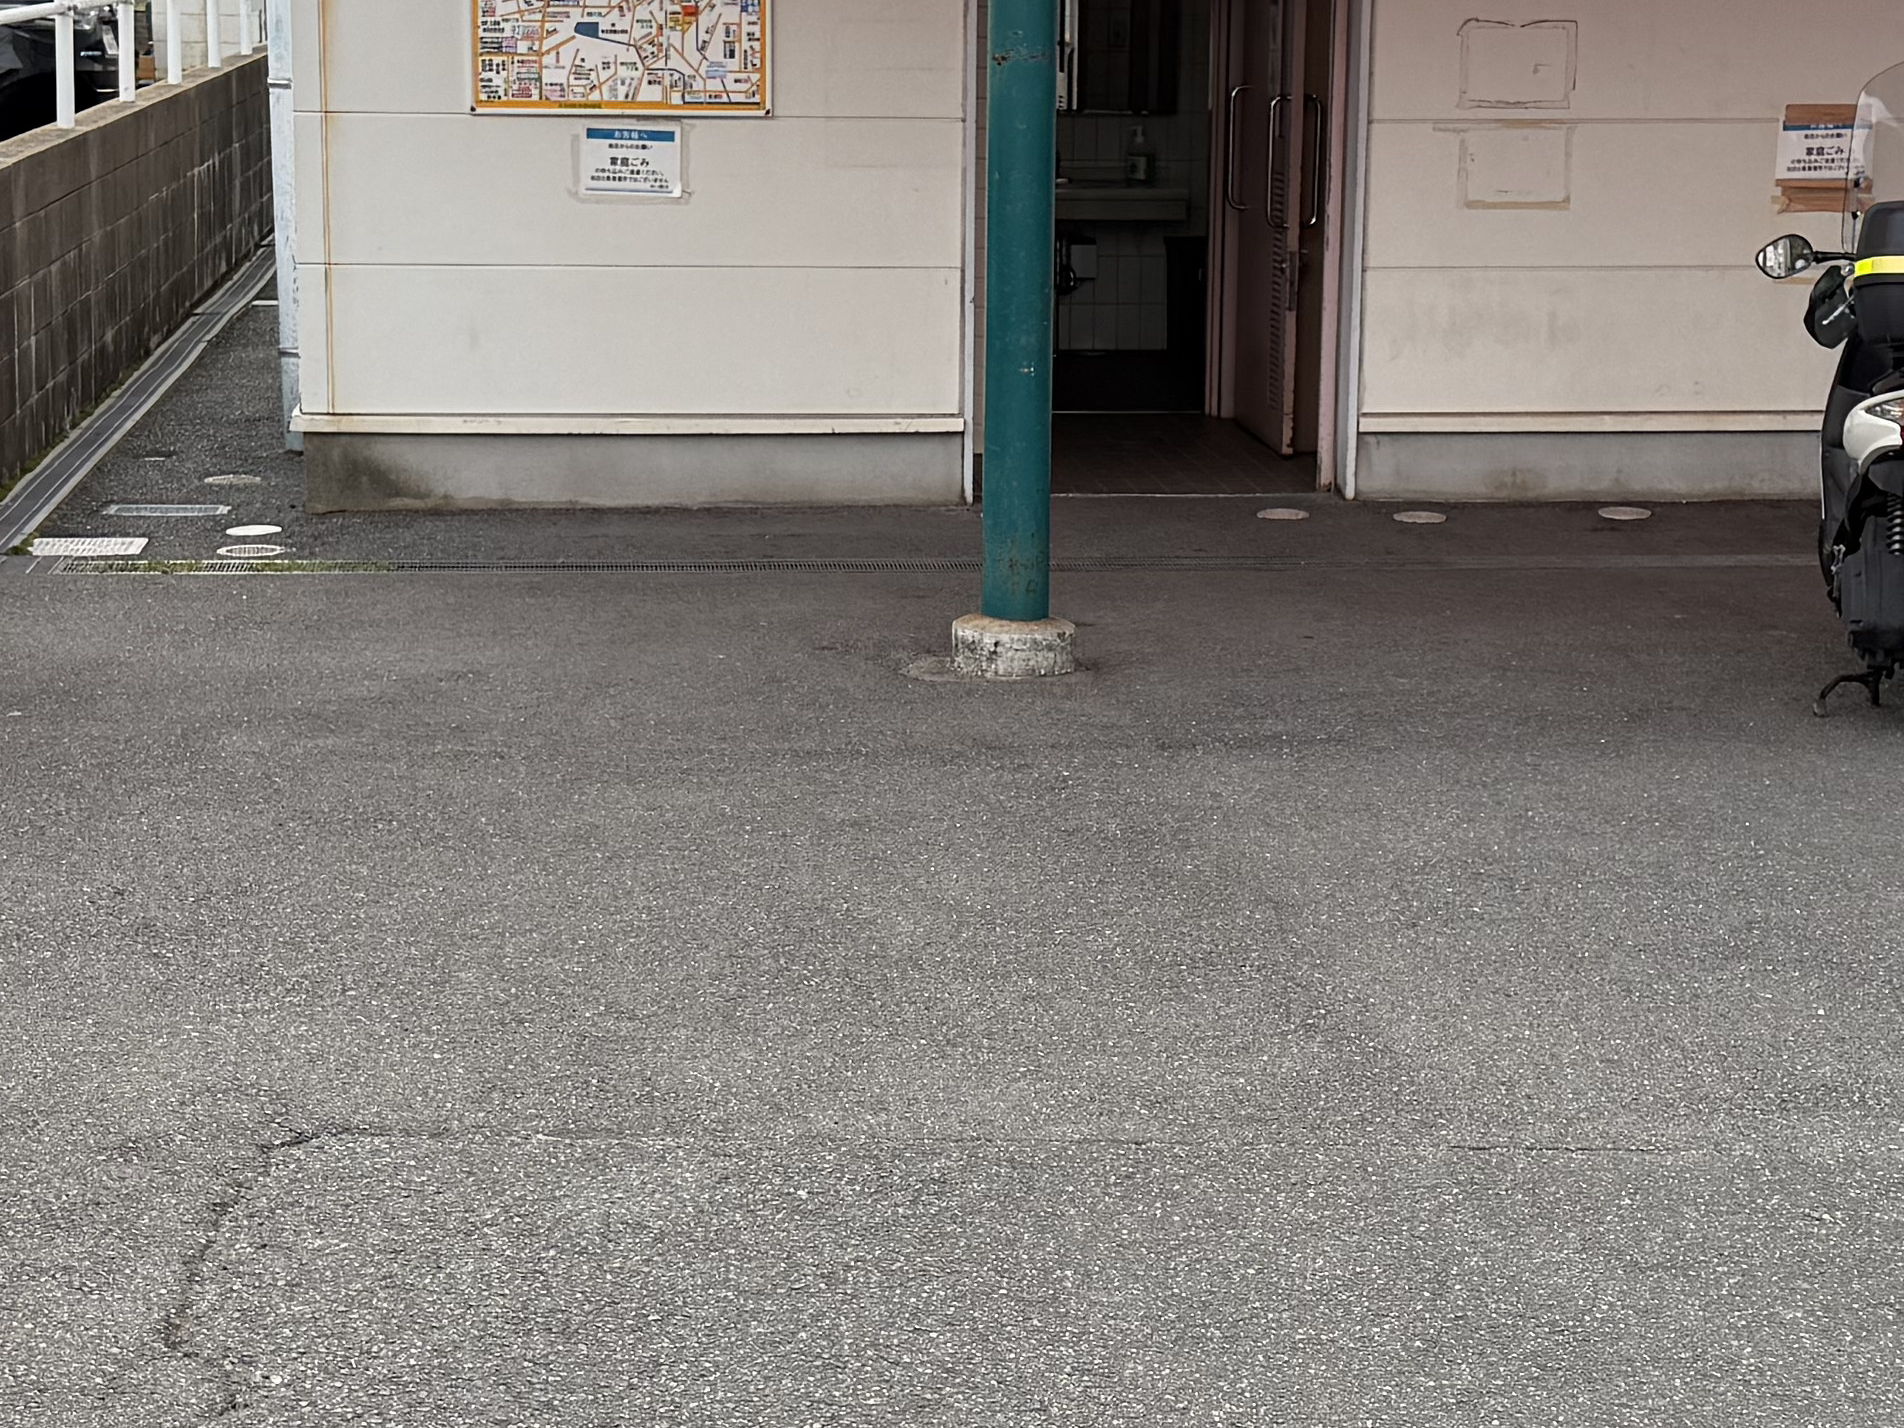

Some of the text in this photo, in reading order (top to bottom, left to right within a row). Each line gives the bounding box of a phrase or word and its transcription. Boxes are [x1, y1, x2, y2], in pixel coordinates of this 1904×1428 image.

[1805, 145, 1845, 157] 家庭ごみ
[609, 156, 650, 168] 家庭ごみ
